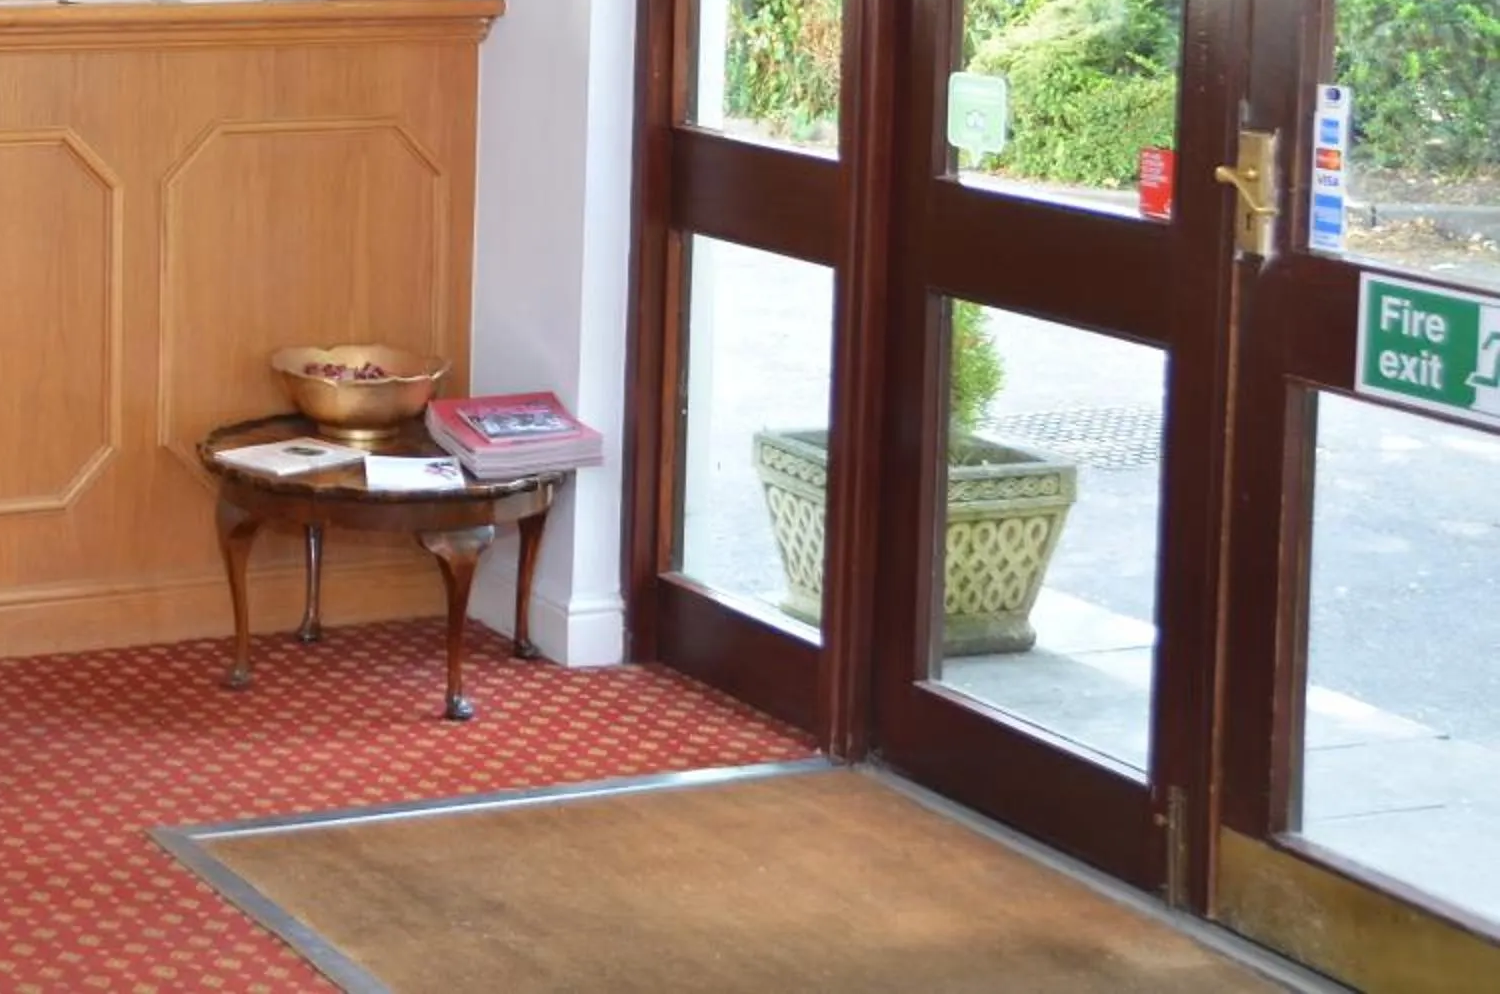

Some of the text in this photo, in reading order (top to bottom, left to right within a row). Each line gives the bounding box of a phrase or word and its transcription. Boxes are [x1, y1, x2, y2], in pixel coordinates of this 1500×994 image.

[1317, 175, 1340, 187] VISA
[1379, 294, 1446, 343] Fire
[1378, 348, 1443, 389] exit
